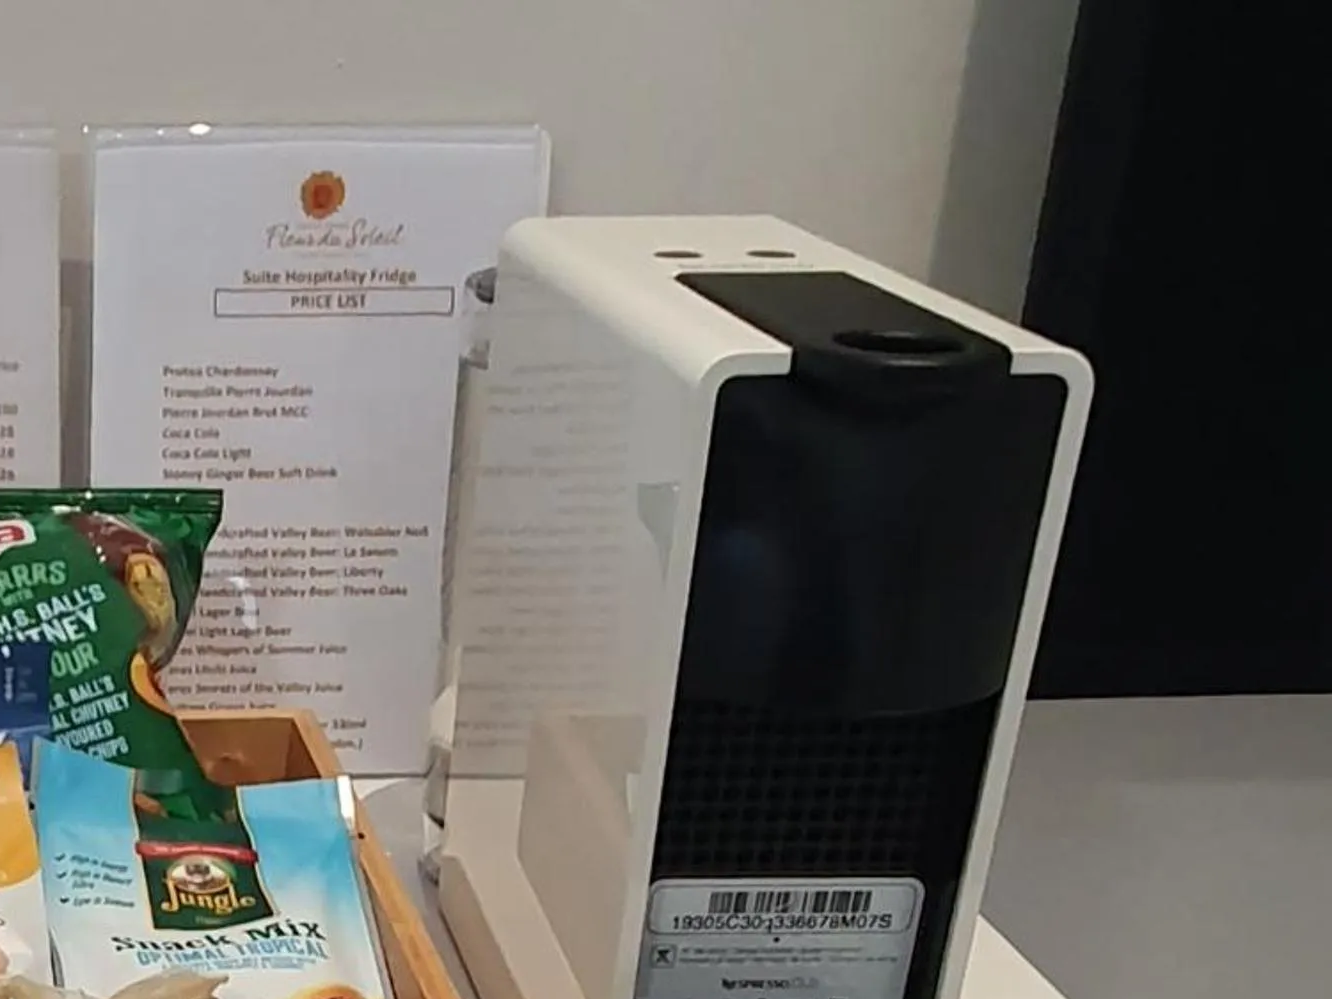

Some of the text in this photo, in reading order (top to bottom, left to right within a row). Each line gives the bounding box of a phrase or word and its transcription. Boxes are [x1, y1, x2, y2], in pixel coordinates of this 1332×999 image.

[243, 268, 416, 285] Suite Hospitality Fridge
[290, 294, 366, 309] PRICE LIST
[163, 366, 279, 378] Protea Chardonnay
[162, 407, 310, 418] Pierre Jourdan Brut MCC
[162, 428, 219, 439] Coca Cola
[162, 448, 252, 462] Coca Cola Light
[163, 467, 337, 482] Stoney Ginger Beer Soft Drink
[272, 527, 306, 540] Valley
[204, 547, 267, 559] andcrafted
[272, 547, 306, 559] Valley
[271, 567, 383, 579] Valley Liberty
[271, 585, 408, 598] Valley Three Oaks
[37, 584, 106, 619] BALL'S
[200, 607, 230, 618] Lager
[199, 627, 227, 638] Light
[161, 877, 256, 915] Jungle
[111, 919, 327, 952] Snack Mix
[235, 939, 328, 960] TROPICAL
